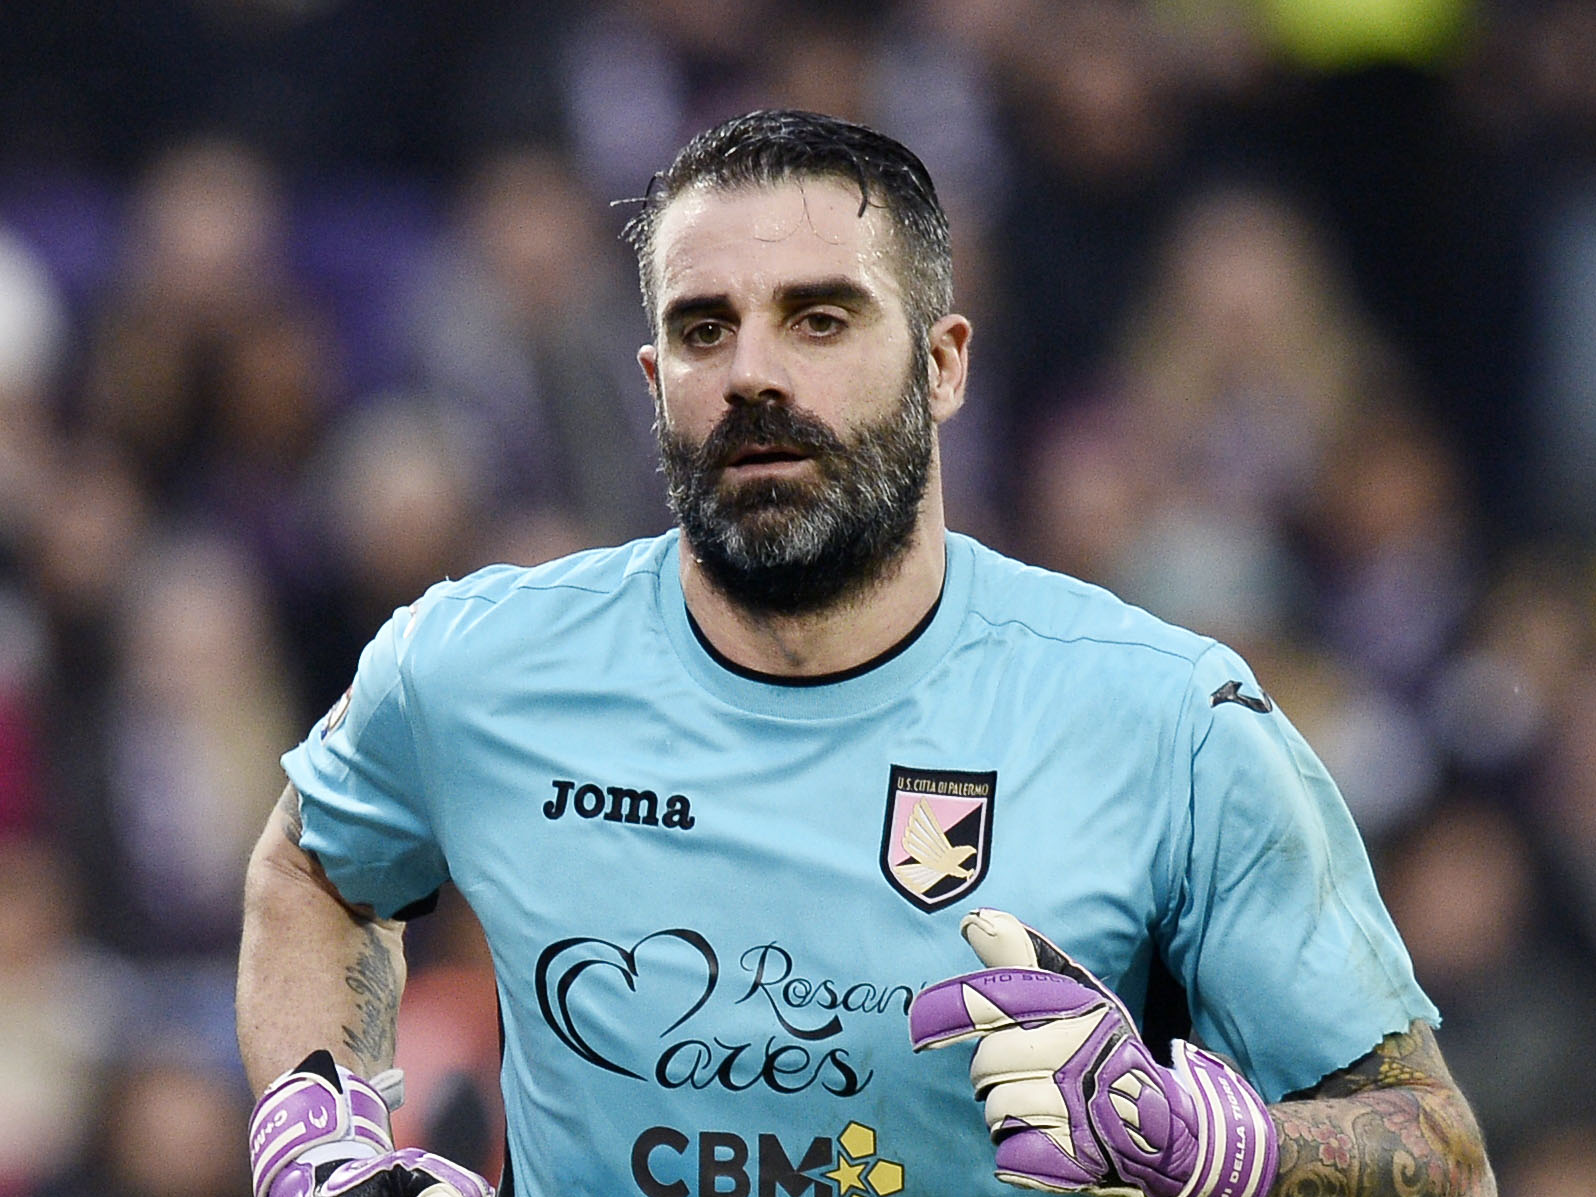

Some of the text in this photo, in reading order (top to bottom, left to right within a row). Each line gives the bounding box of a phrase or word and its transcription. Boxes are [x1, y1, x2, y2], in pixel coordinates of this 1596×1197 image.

[542, 779, 696, 831] Joma
[937, 780, 948, 794] DI
[948, 781, 989, 797] PALERMO
[734, 940, 927, 1041] Rosan
[1228, 1125, 1247, 1184] DELLA
